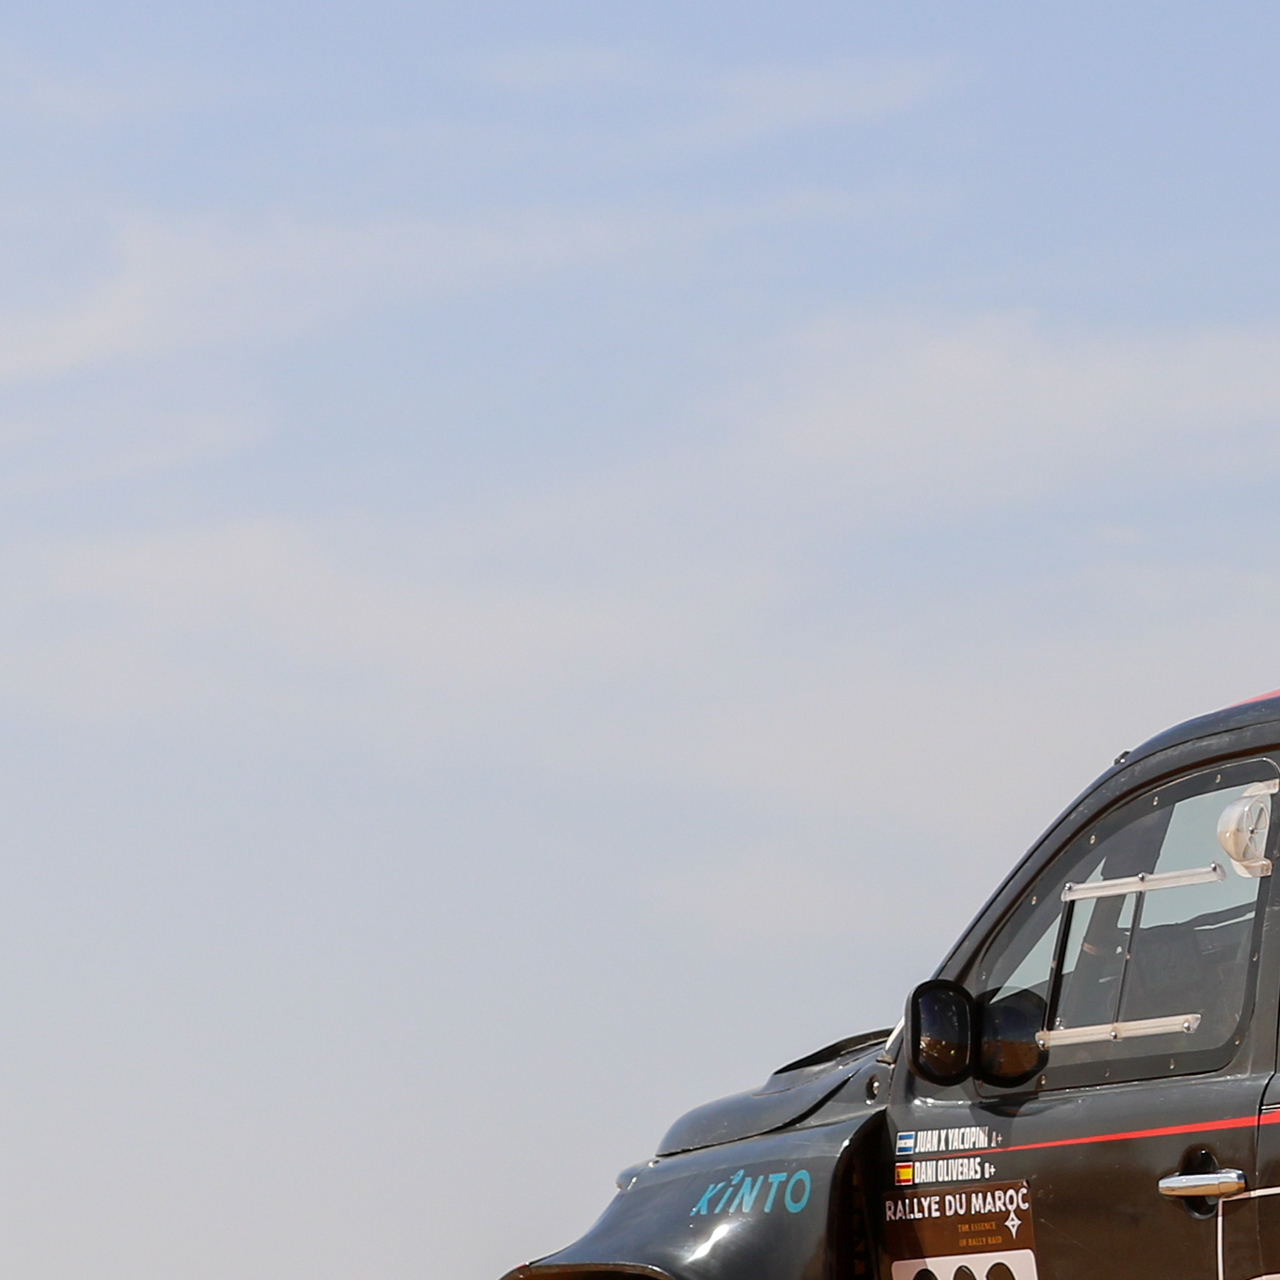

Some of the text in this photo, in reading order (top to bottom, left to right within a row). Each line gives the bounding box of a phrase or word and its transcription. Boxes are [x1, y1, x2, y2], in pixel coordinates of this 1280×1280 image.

[915, 1130, 939, 1153] JUAN
[914, 1160, 937, 1184] DANI
[938, 1157, 981, 1181] OLIVERAS
[886, 1187, 1029, 1221] RALLYE DU MAROC
